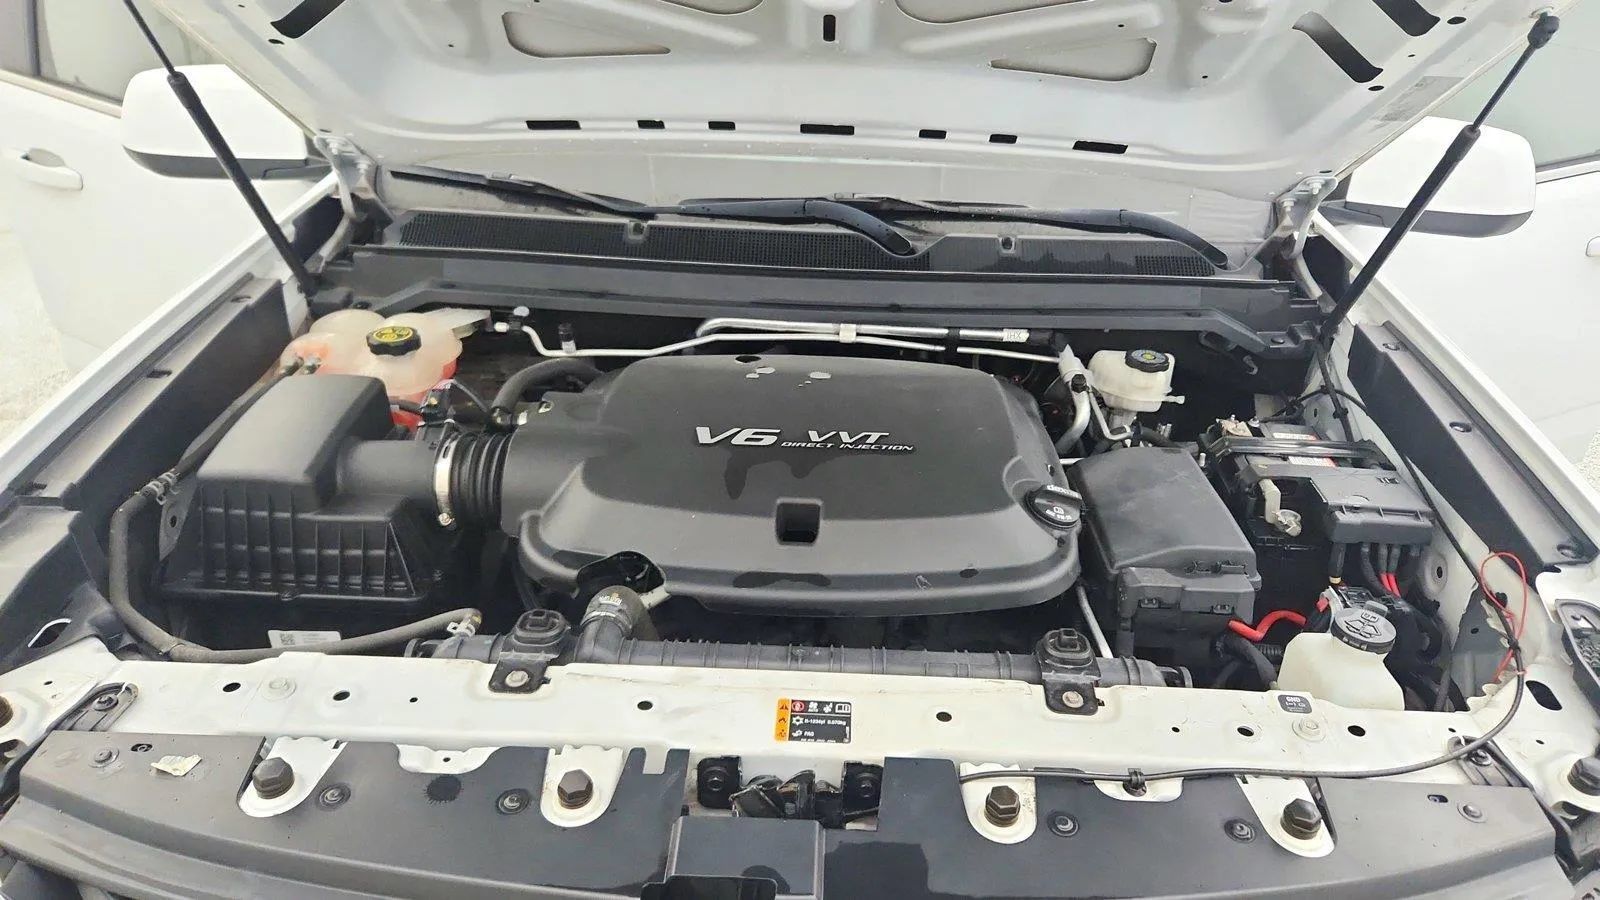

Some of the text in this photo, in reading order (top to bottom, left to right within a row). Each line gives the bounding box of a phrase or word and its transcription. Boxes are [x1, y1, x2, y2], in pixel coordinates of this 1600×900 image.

[696, 426, 890, 446] V6 VVT
[781, 441, 914, 451] DIRECT INJECTION
